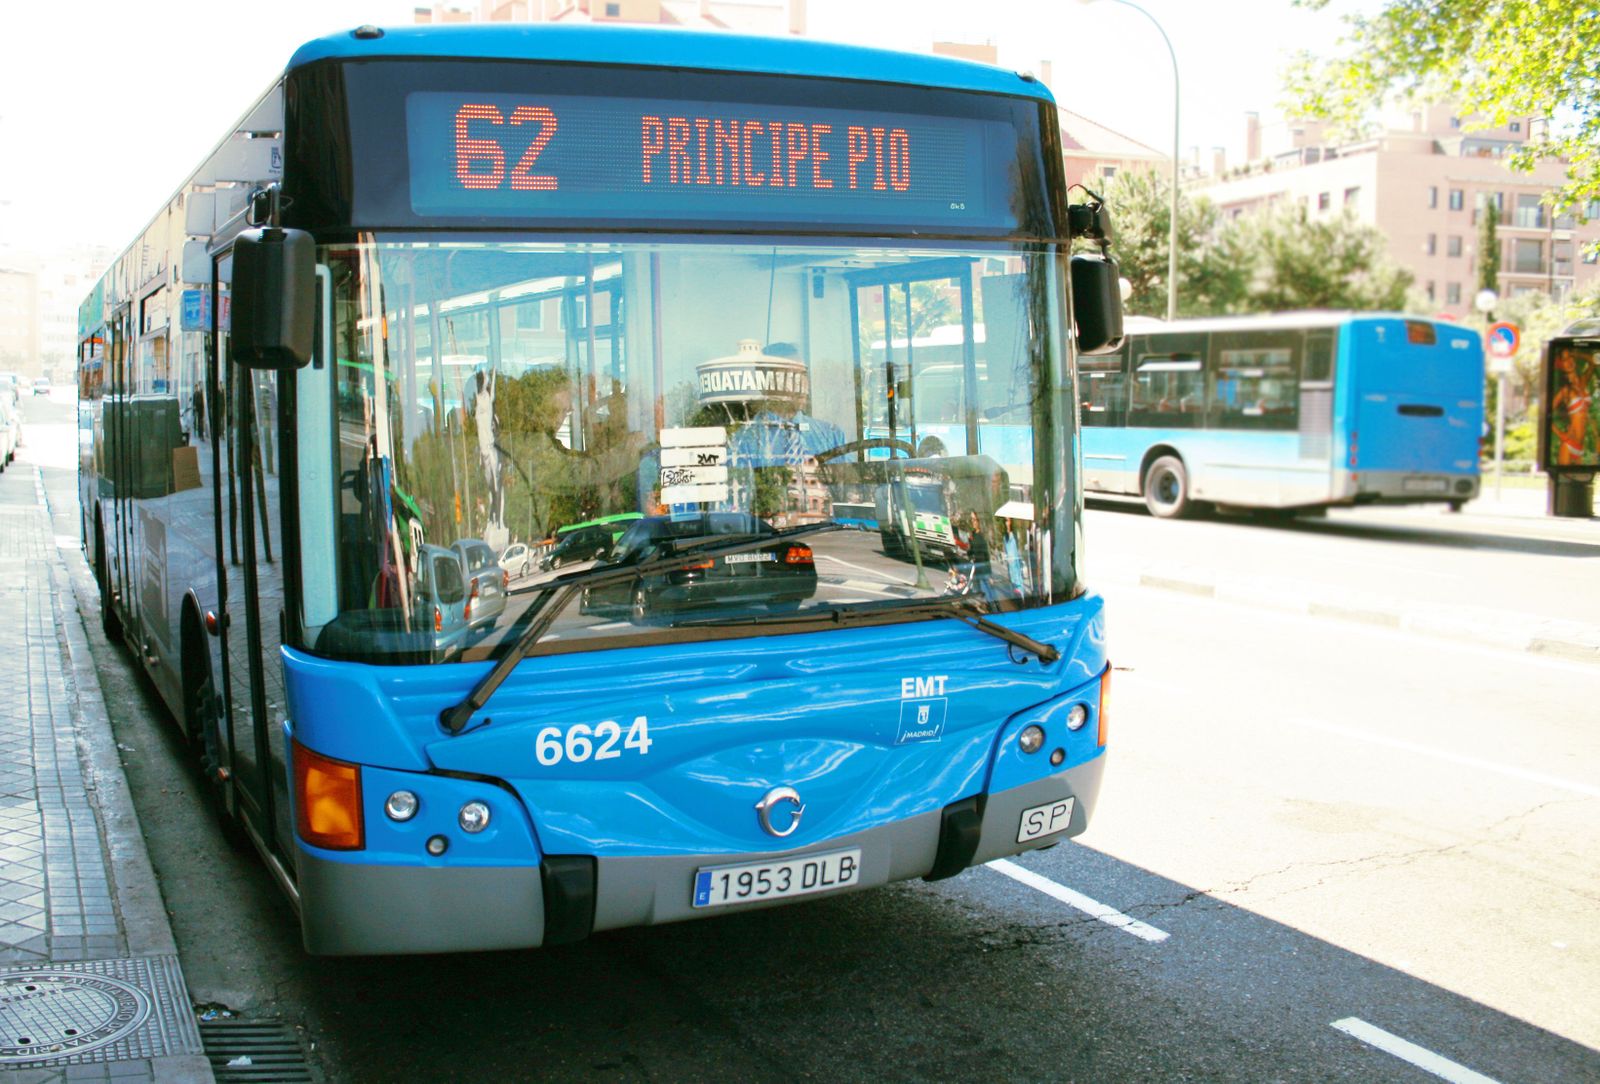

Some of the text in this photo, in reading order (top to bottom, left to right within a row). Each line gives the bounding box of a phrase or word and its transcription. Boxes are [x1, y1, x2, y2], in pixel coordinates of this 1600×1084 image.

[456, 103, 910, 191] 62 PRINCIPE PIO
[901, 674, 949, 699] EMT
[535, 715, 653, 767] 6624
[1026, 803, 1067, 836] SP
[720, 855, 854, 900] 1953 DLB
